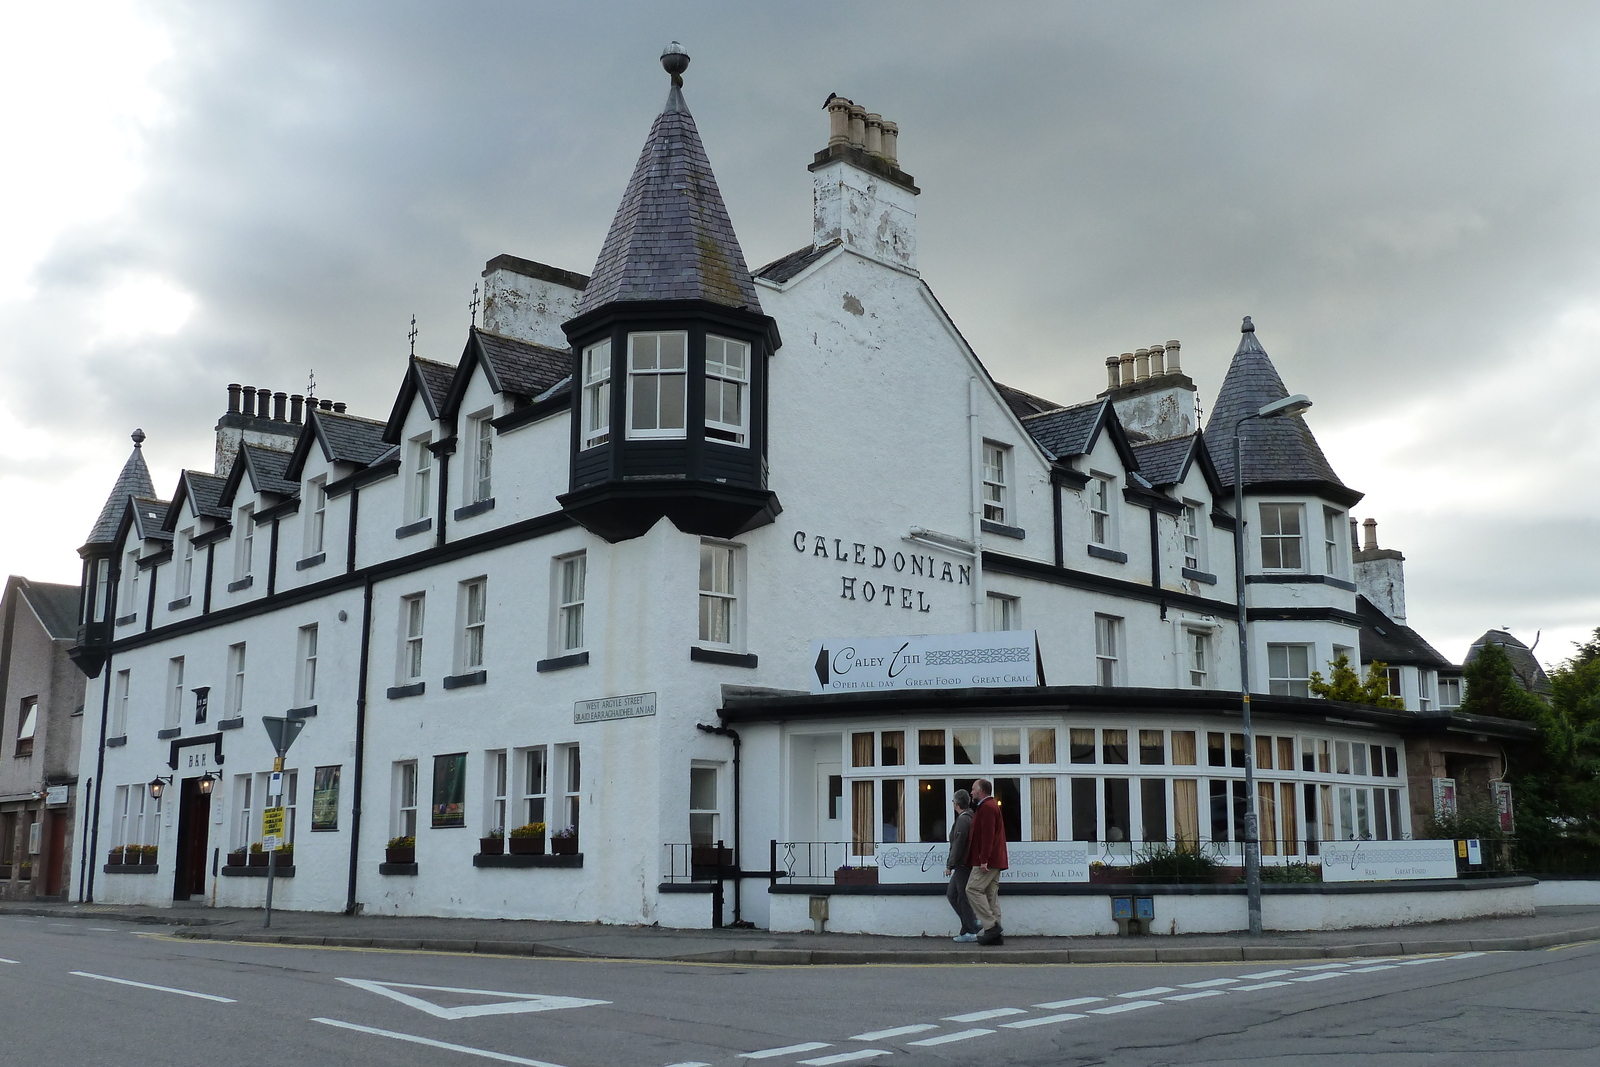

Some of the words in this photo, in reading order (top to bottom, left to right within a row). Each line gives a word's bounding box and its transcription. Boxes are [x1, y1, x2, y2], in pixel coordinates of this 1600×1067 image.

[793, 530, 971, 586] CALEDONIAN
[841, 576, 931, 613] HOTEL
[860, 680, 875, 688] ALL
[878, 680, 895, 688] DAY
[905, 677, 934, 687] GREAT
[936, 676, 962, 686] FOOD
[971, 674, 1001, 684] GREAT
[1003, 673, 1032, 683] CRAIC
[586, 701, 600, 710] WEST
[601, 698, 622, 709] ARGYLE
[624, 696, 644, 706] STREET
[591, 707, 634, 720] EARRAGHAIDHEIL
[635, 706, 644, 714] AN
[188, 753, 207, 768] BAR
[1016, 870, 1039, 878] FOOD
[1050, 869, 1066, 878] ALL
[1068, 869, 1084, 878] DAY
[1364, 868, 1378, 876] REAL
[1411, 867, 1427, 875] FOOD
